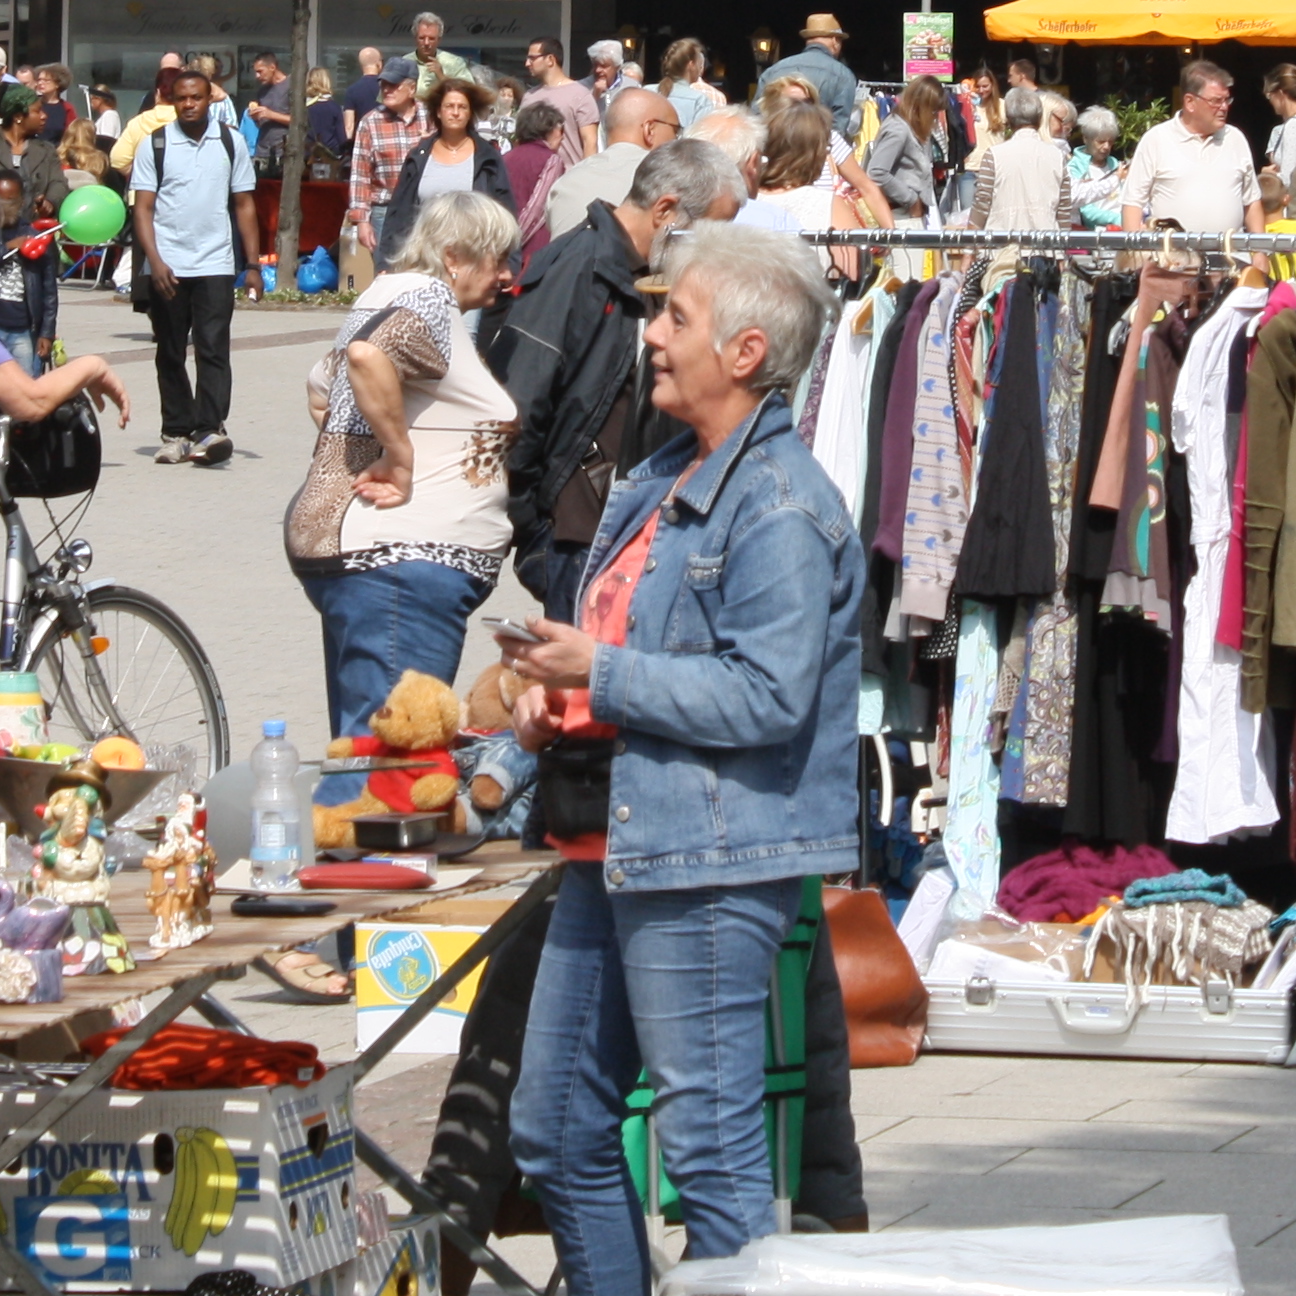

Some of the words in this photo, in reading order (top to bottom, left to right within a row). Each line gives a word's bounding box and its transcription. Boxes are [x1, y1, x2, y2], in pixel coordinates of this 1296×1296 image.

[1037, 18, 1098, 34] Schöfferhofer
[1215, 18, 1275, 32] Schöfferhofer
[370, 931, 424, 970] Chiquita
[27, 1142, 156, 1202] BONITA
